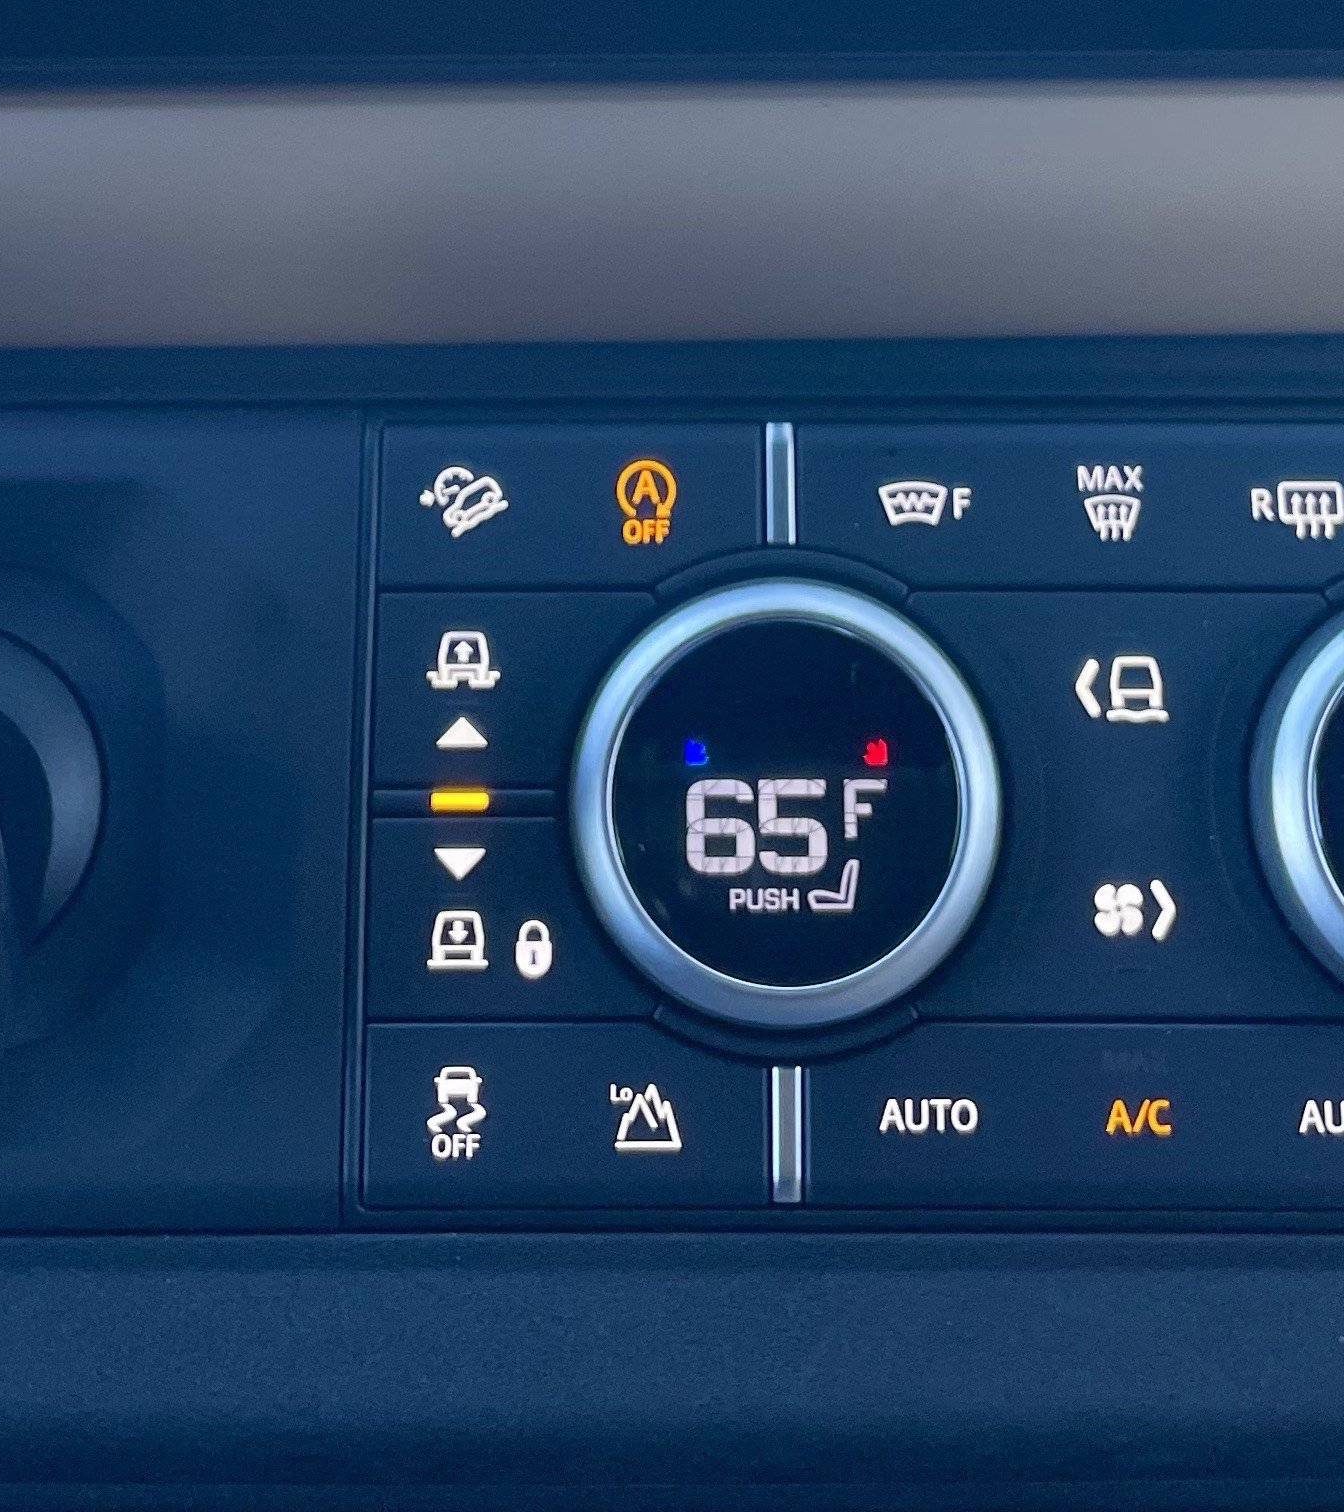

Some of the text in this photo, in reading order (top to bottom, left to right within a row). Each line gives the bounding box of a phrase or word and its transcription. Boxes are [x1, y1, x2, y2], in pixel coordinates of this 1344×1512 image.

[1076, 465, 1143, 492] MAX
[952, 487, 972, 520] F
[1251, 487, 1274, 520] R
[621, 519, 670, 545] OFF
[729, 888, 800, 910] PUSH
[879, 1098, 979, 1133] AUTO
[1106, 1098, 1171, 1135] A/C
[431, 1133, 480, 1159] OFF
